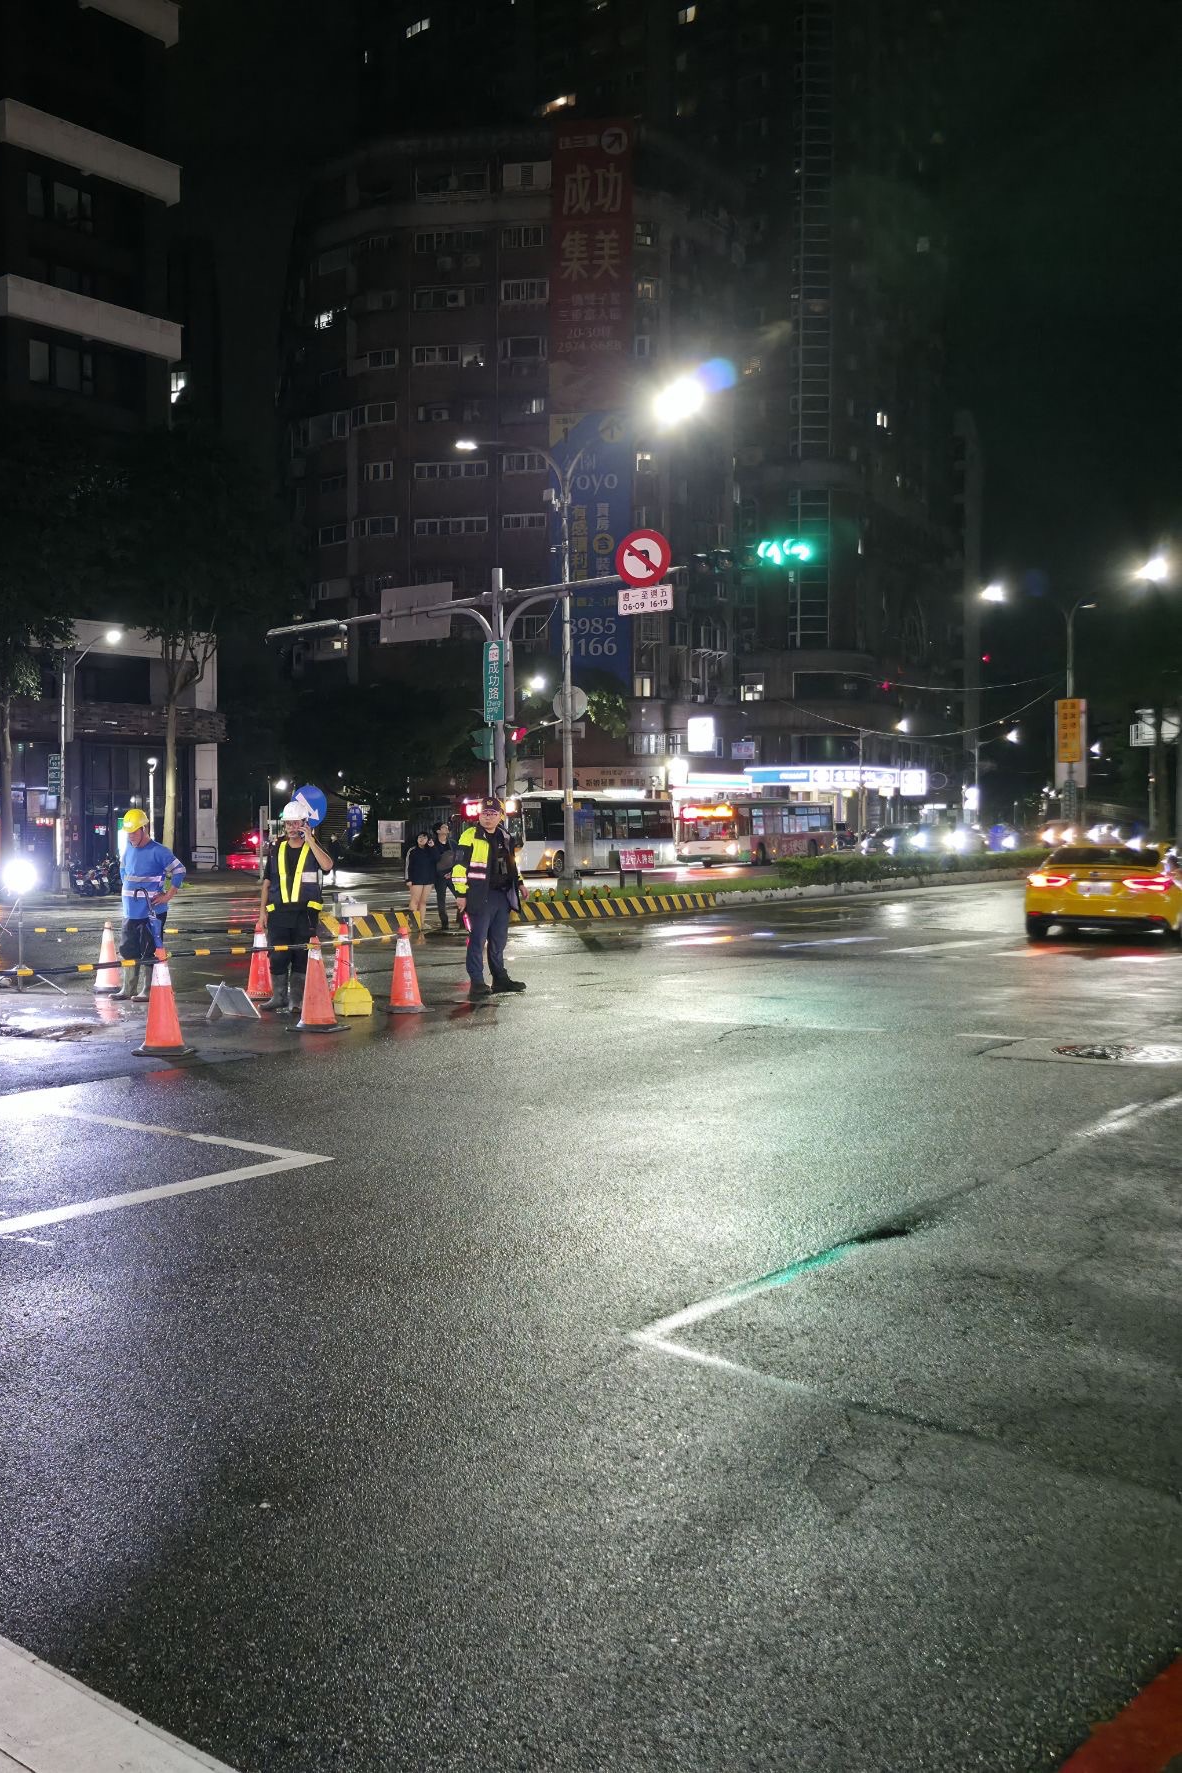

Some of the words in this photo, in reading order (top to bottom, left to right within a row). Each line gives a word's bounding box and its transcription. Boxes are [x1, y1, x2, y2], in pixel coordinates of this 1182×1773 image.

[563, 162, 623, 216] 成功
[560, 229, 621, 282] 集美
[623, 589, 667, 601] 週一至週五
[488, 661, 500, 700] 成功路
